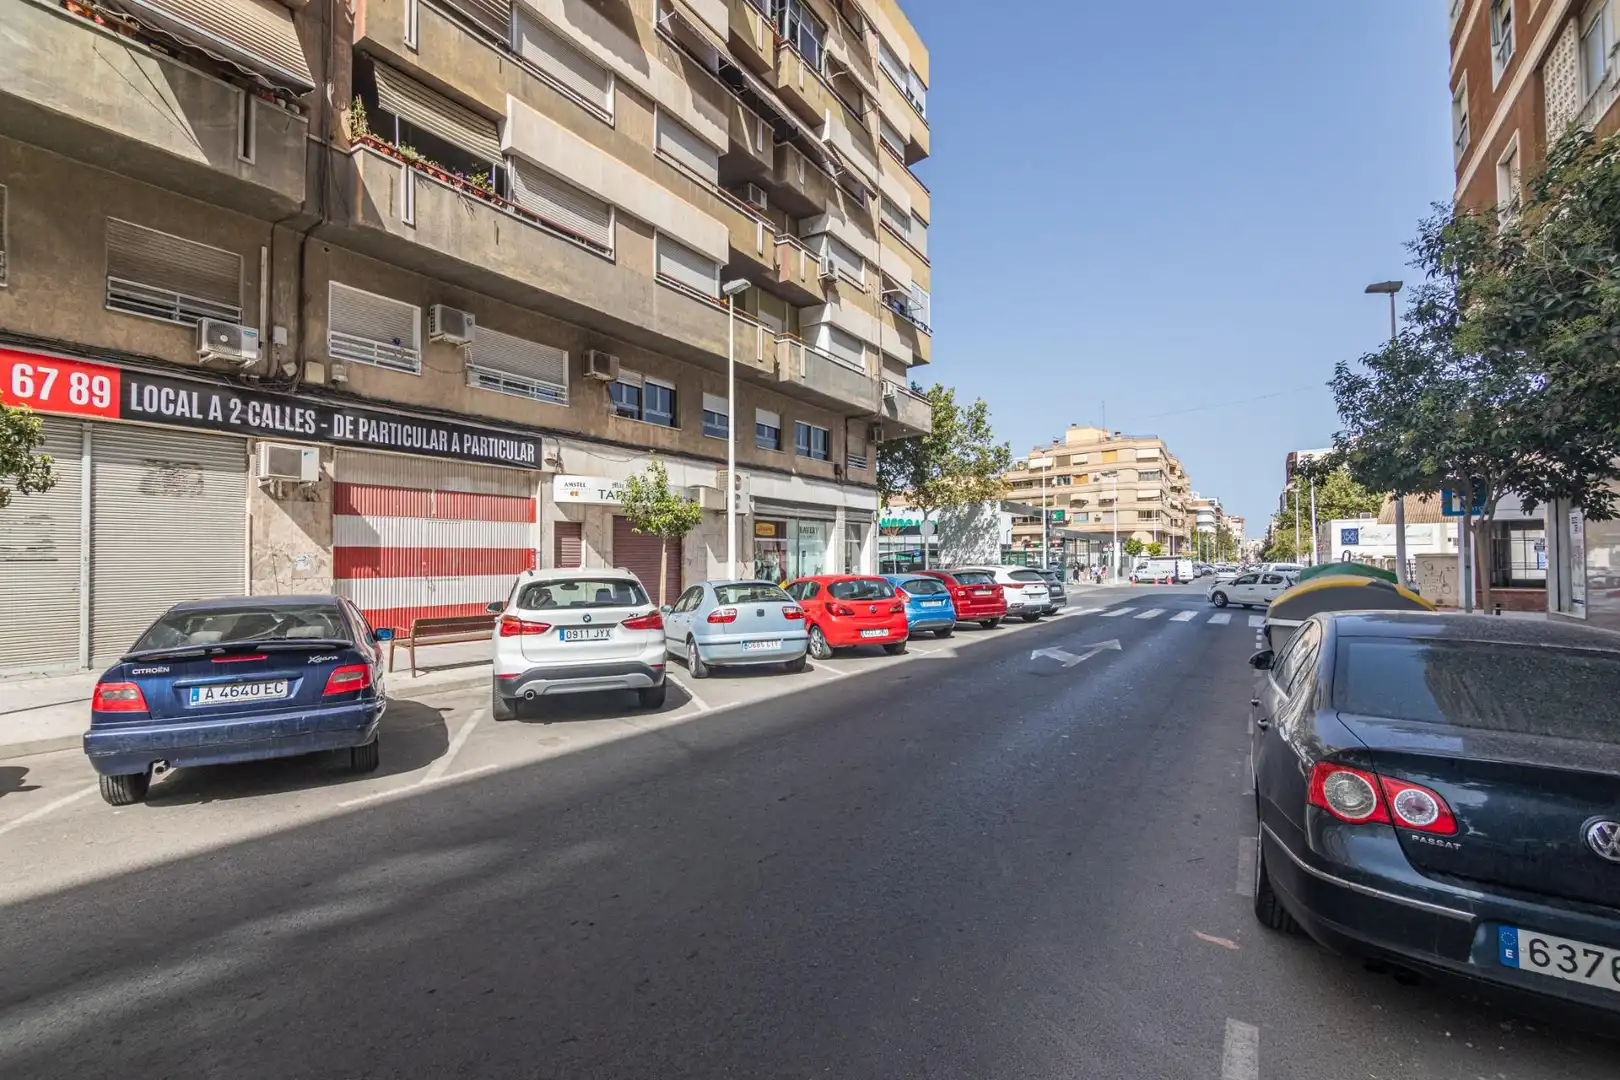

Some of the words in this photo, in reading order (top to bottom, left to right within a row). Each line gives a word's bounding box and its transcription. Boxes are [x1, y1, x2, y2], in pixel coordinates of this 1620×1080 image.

[12, 363, 59, 400] 67
[69, 371, 111, 408] 89
[130, 382, 203, 419] LOCAL
[208, 395, 223, 422] A
[229, 398, 242, 425] 2
[248, 401, 316, 434] CALLES
[333, 413, 354, 439] DE
[359, 417, 448, 451] PARTICULAR
[451, 432, 460, 453] A
[463, 434, 535, 463] PARTICULAR
[566, 630, 590, 639] 0911
[593, 629, 611, 638] JYX
[205, 687, 215, 700] A
[219, 683, 260, 699] 4640
[264, 681, 284, 695] EC
[1411, 834, 1462, 850] PASSAT
[1505, 948, 1514, 959] E
